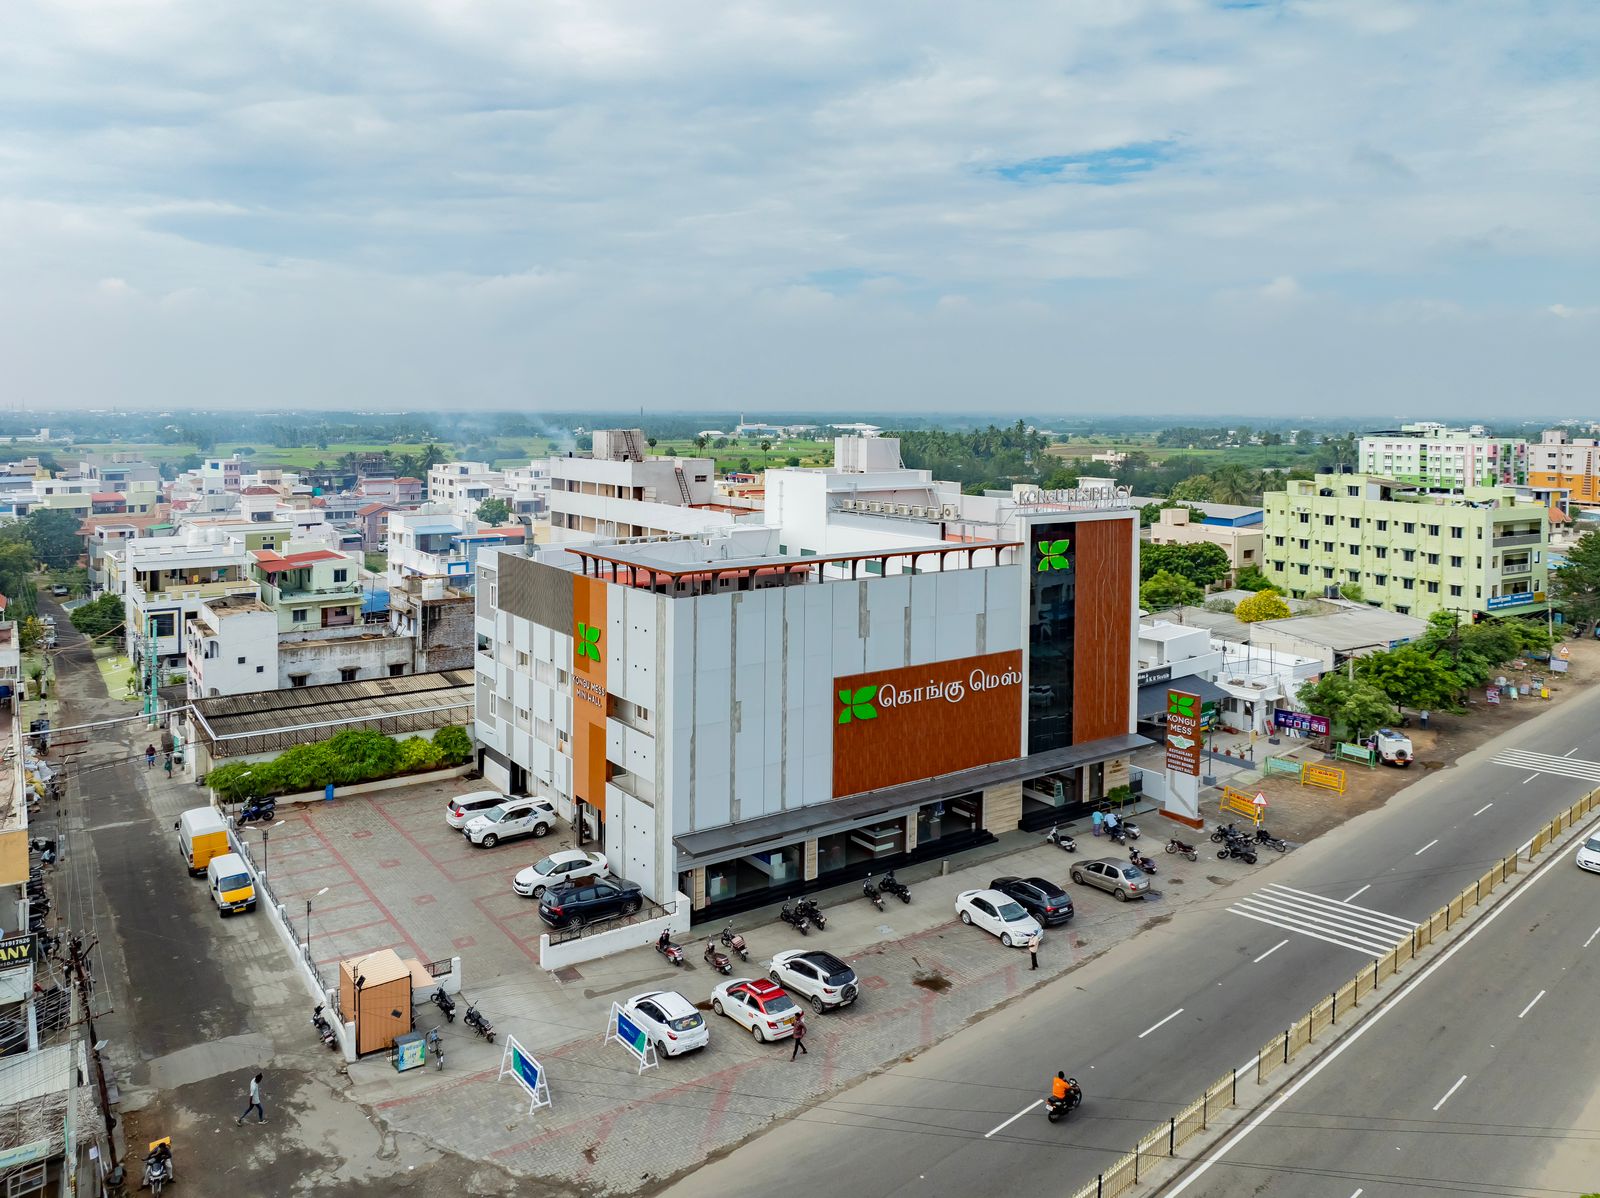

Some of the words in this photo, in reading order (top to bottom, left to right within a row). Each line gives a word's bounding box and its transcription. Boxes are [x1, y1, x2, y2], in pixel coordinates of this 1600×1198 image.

[1019, 489, 1064, 505] KONGU
[1067, 485, 1133, 501] RESIDENCY
[591, 683, 605, 696] MESS
[878, 680, 965, 708] கொங்கு
[969, 666, 1022, 692] மெஸ்
[1167, 714, 1196, 727] KONGU
[1170, 724, 1192, 735] MESS
